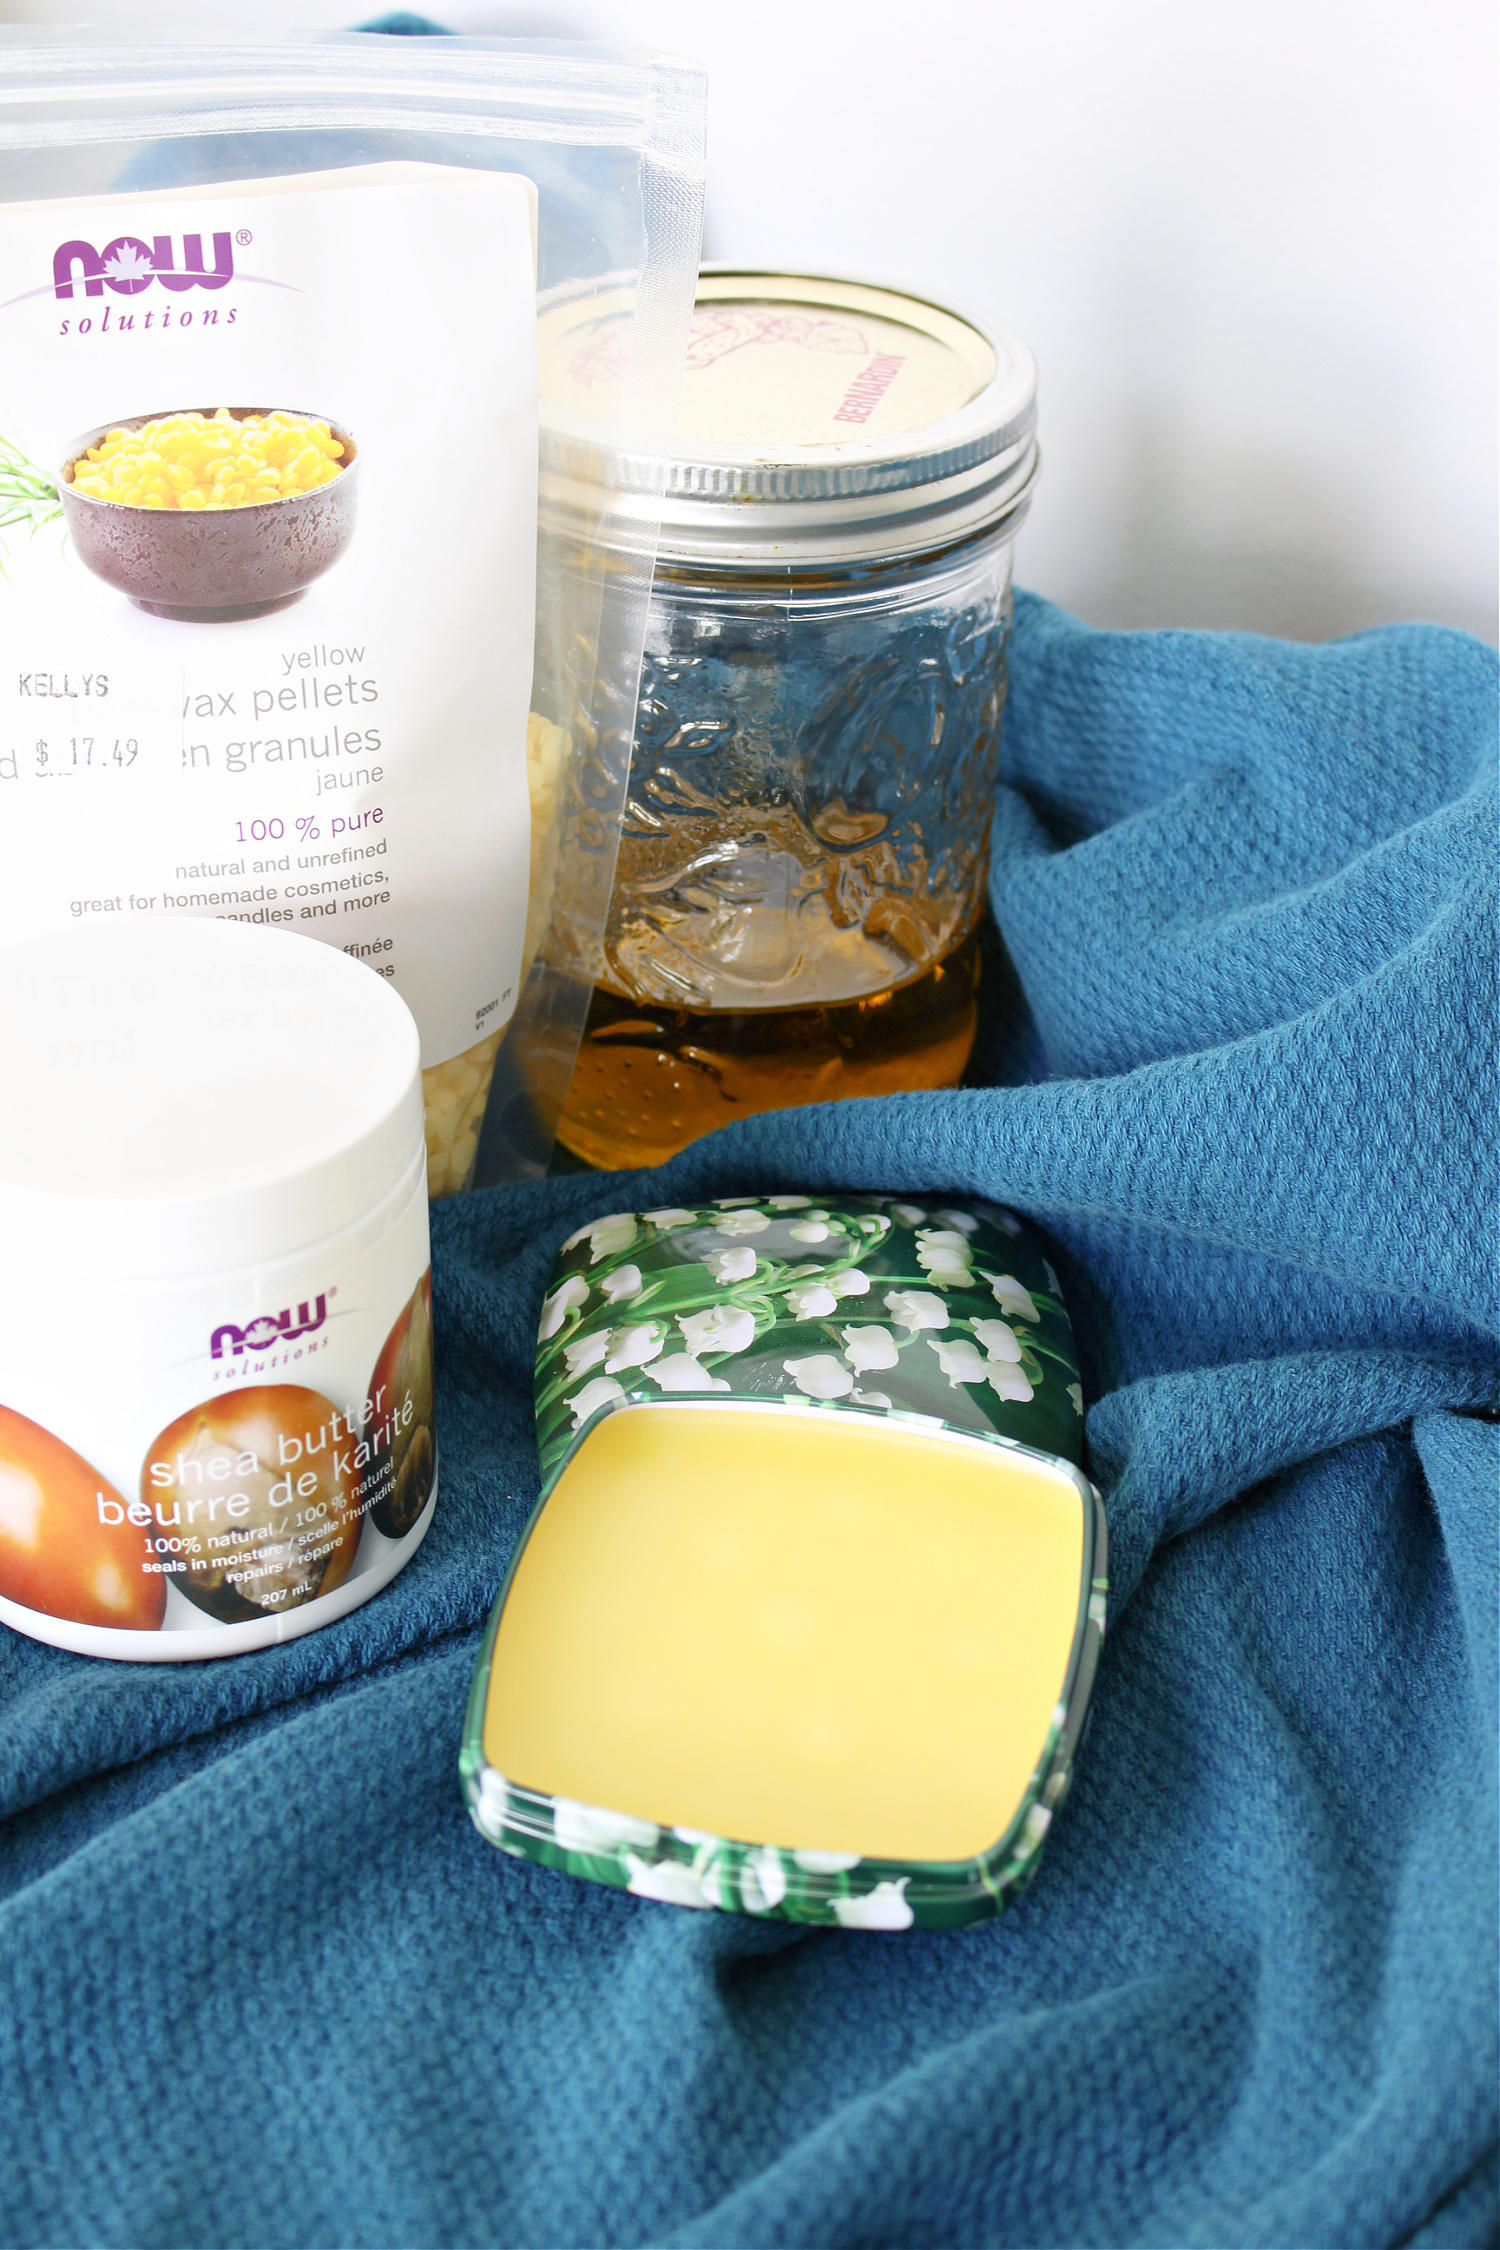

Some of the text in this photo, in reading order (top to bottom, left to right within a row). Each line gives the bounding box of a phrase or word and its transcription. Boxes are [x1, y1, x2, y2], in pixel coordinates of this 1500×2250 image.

[59, 304, 238, 336] solutions
[833, 351, 907, 424] BERNARDIN
[281, 644, 365, 676] yellow
[18, 673, 109, 698] KELLYS
[253, 674, 379, 721] pellets
[36, 737, 138, 767] $ 17.49
[225, 725, 382, 773] granules
[316, 766, 384, 796] jaune
[235, 818, 285, 842] 100
[331, 807, 384, 838] pure
[175, 838, 388, 879] natural and unrefined
[70, 870, 390, 917] great for homemade cosmetics,
[300, 899, 337, 919] and
[343, 890, 391, 913] more
[213, 1334, 330, 1381] solutions
[97, 1390, 414, 1527] beurre de karité
[150, 1385, 386, 1487] shea butter
[144, 1537, 201, 1553] 100%
[207, 1522, 273, 1549] natural
[295, 1501, 327, 1527] 100
[351, 1456, 394, 1501] naturel
[142, 1560, 186, 1573] seals
[191, 1557, 206, 1570] in
[211, 1543, 283, 1568] moisture
[298, 1520, 339, 1547] scelle
[226, 1564, 284, 1585] repairs
[298, 1536, 343, 1567] répare
[261, 1583, 312, 1606] 207 mL
